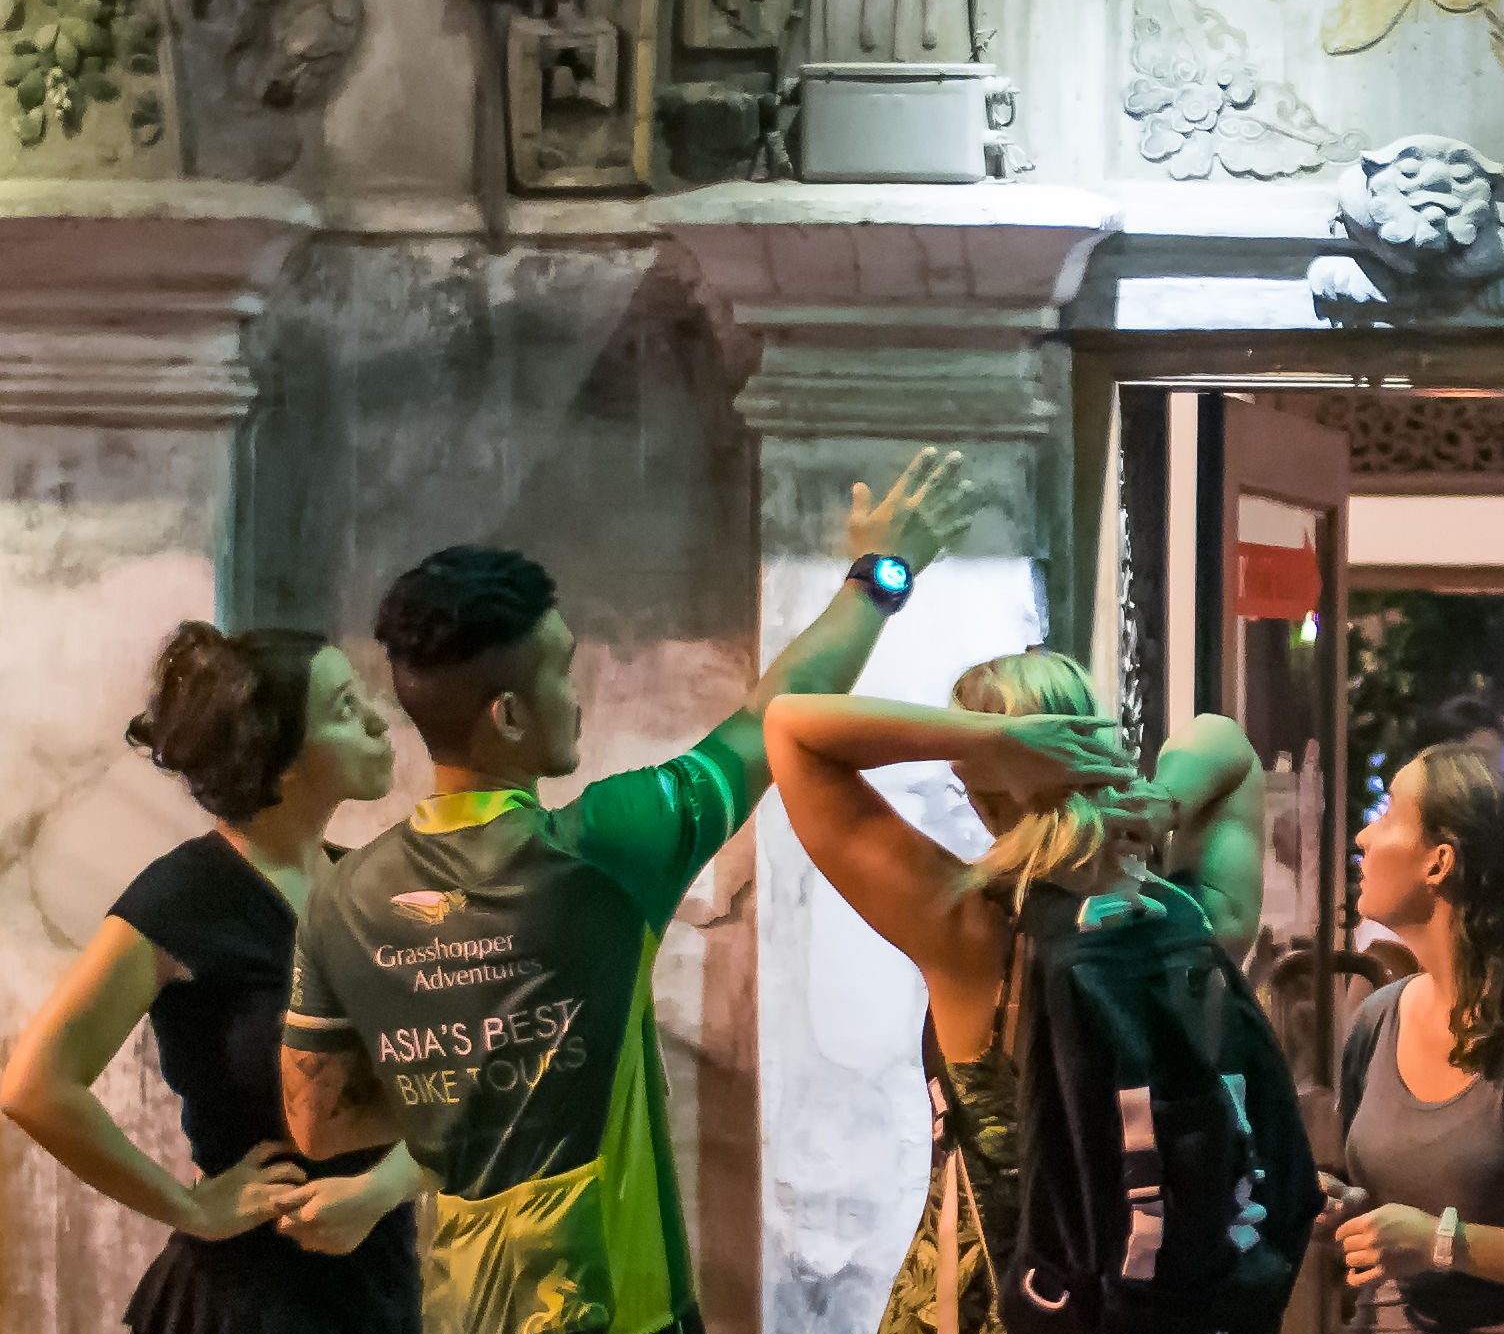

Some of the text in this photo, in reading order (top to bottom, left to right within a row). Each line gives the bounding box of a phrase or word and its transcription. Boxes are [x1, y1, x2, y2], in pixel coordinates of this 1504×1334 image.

[374, 934, 515, 968] Grasshopper
[413, 957, 543, 993] Adventures
[379, 998, 578, 1062] ASIA'S BEST
[396, 1070, 461, 1106] BIKE
